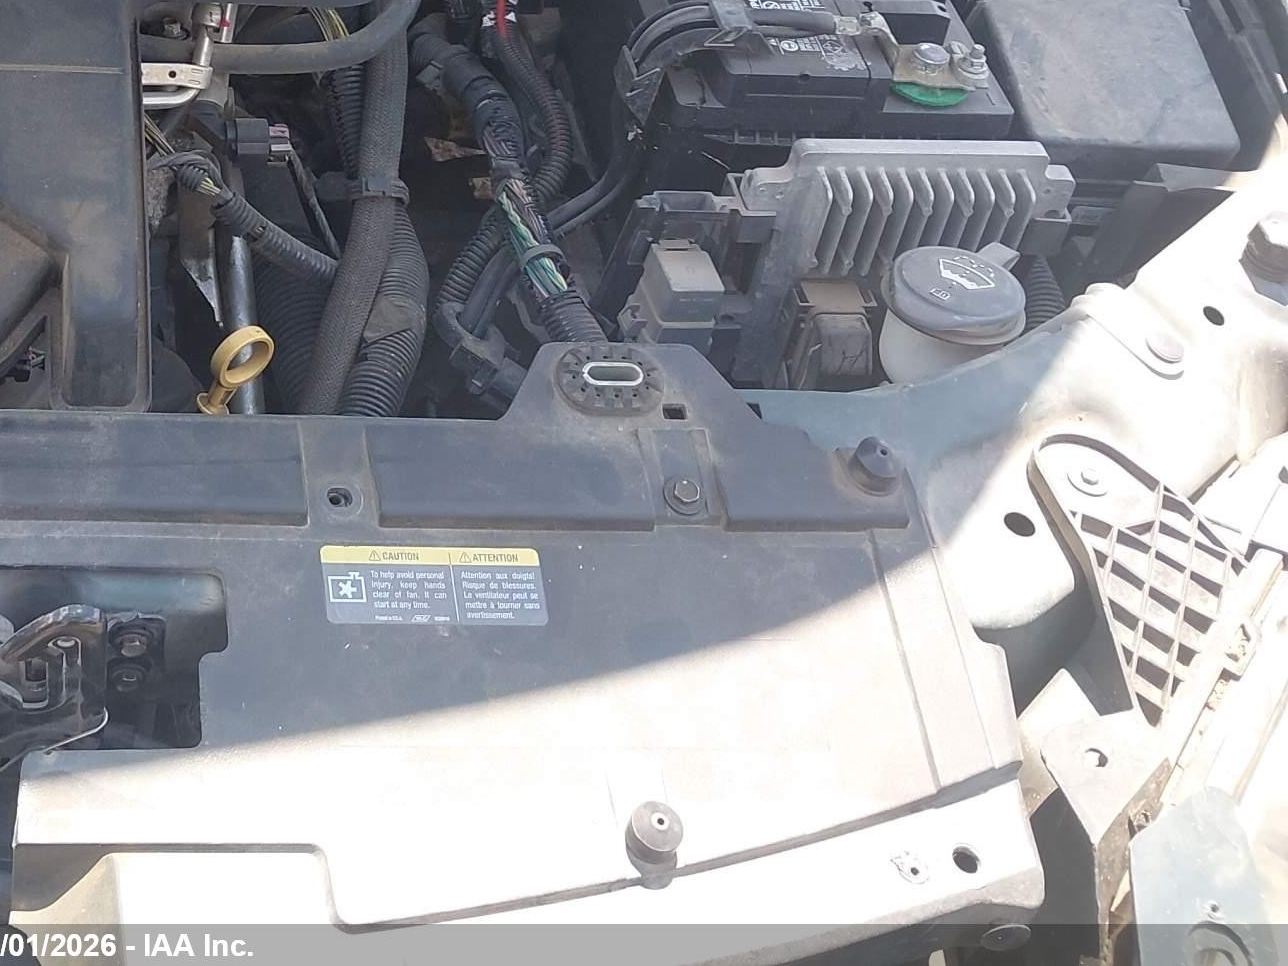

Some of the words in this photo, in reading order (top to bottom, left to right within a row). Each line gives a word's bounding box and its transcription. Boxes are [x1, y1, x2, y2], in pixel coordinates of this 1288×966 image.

[383, 553, 419, 561] CAUTION
[473, 554, 518, 562] ATTENTION
[371, 570, 379, 578] To
[380, 570, 394, 579] help
[416, 572, 444, 580] personal
[461, 571, 491, 579] Attention
[400, 581, 417, 589] keep
[462, 581, 485, 589] Risque
[373, 590, 389, 598] clear
